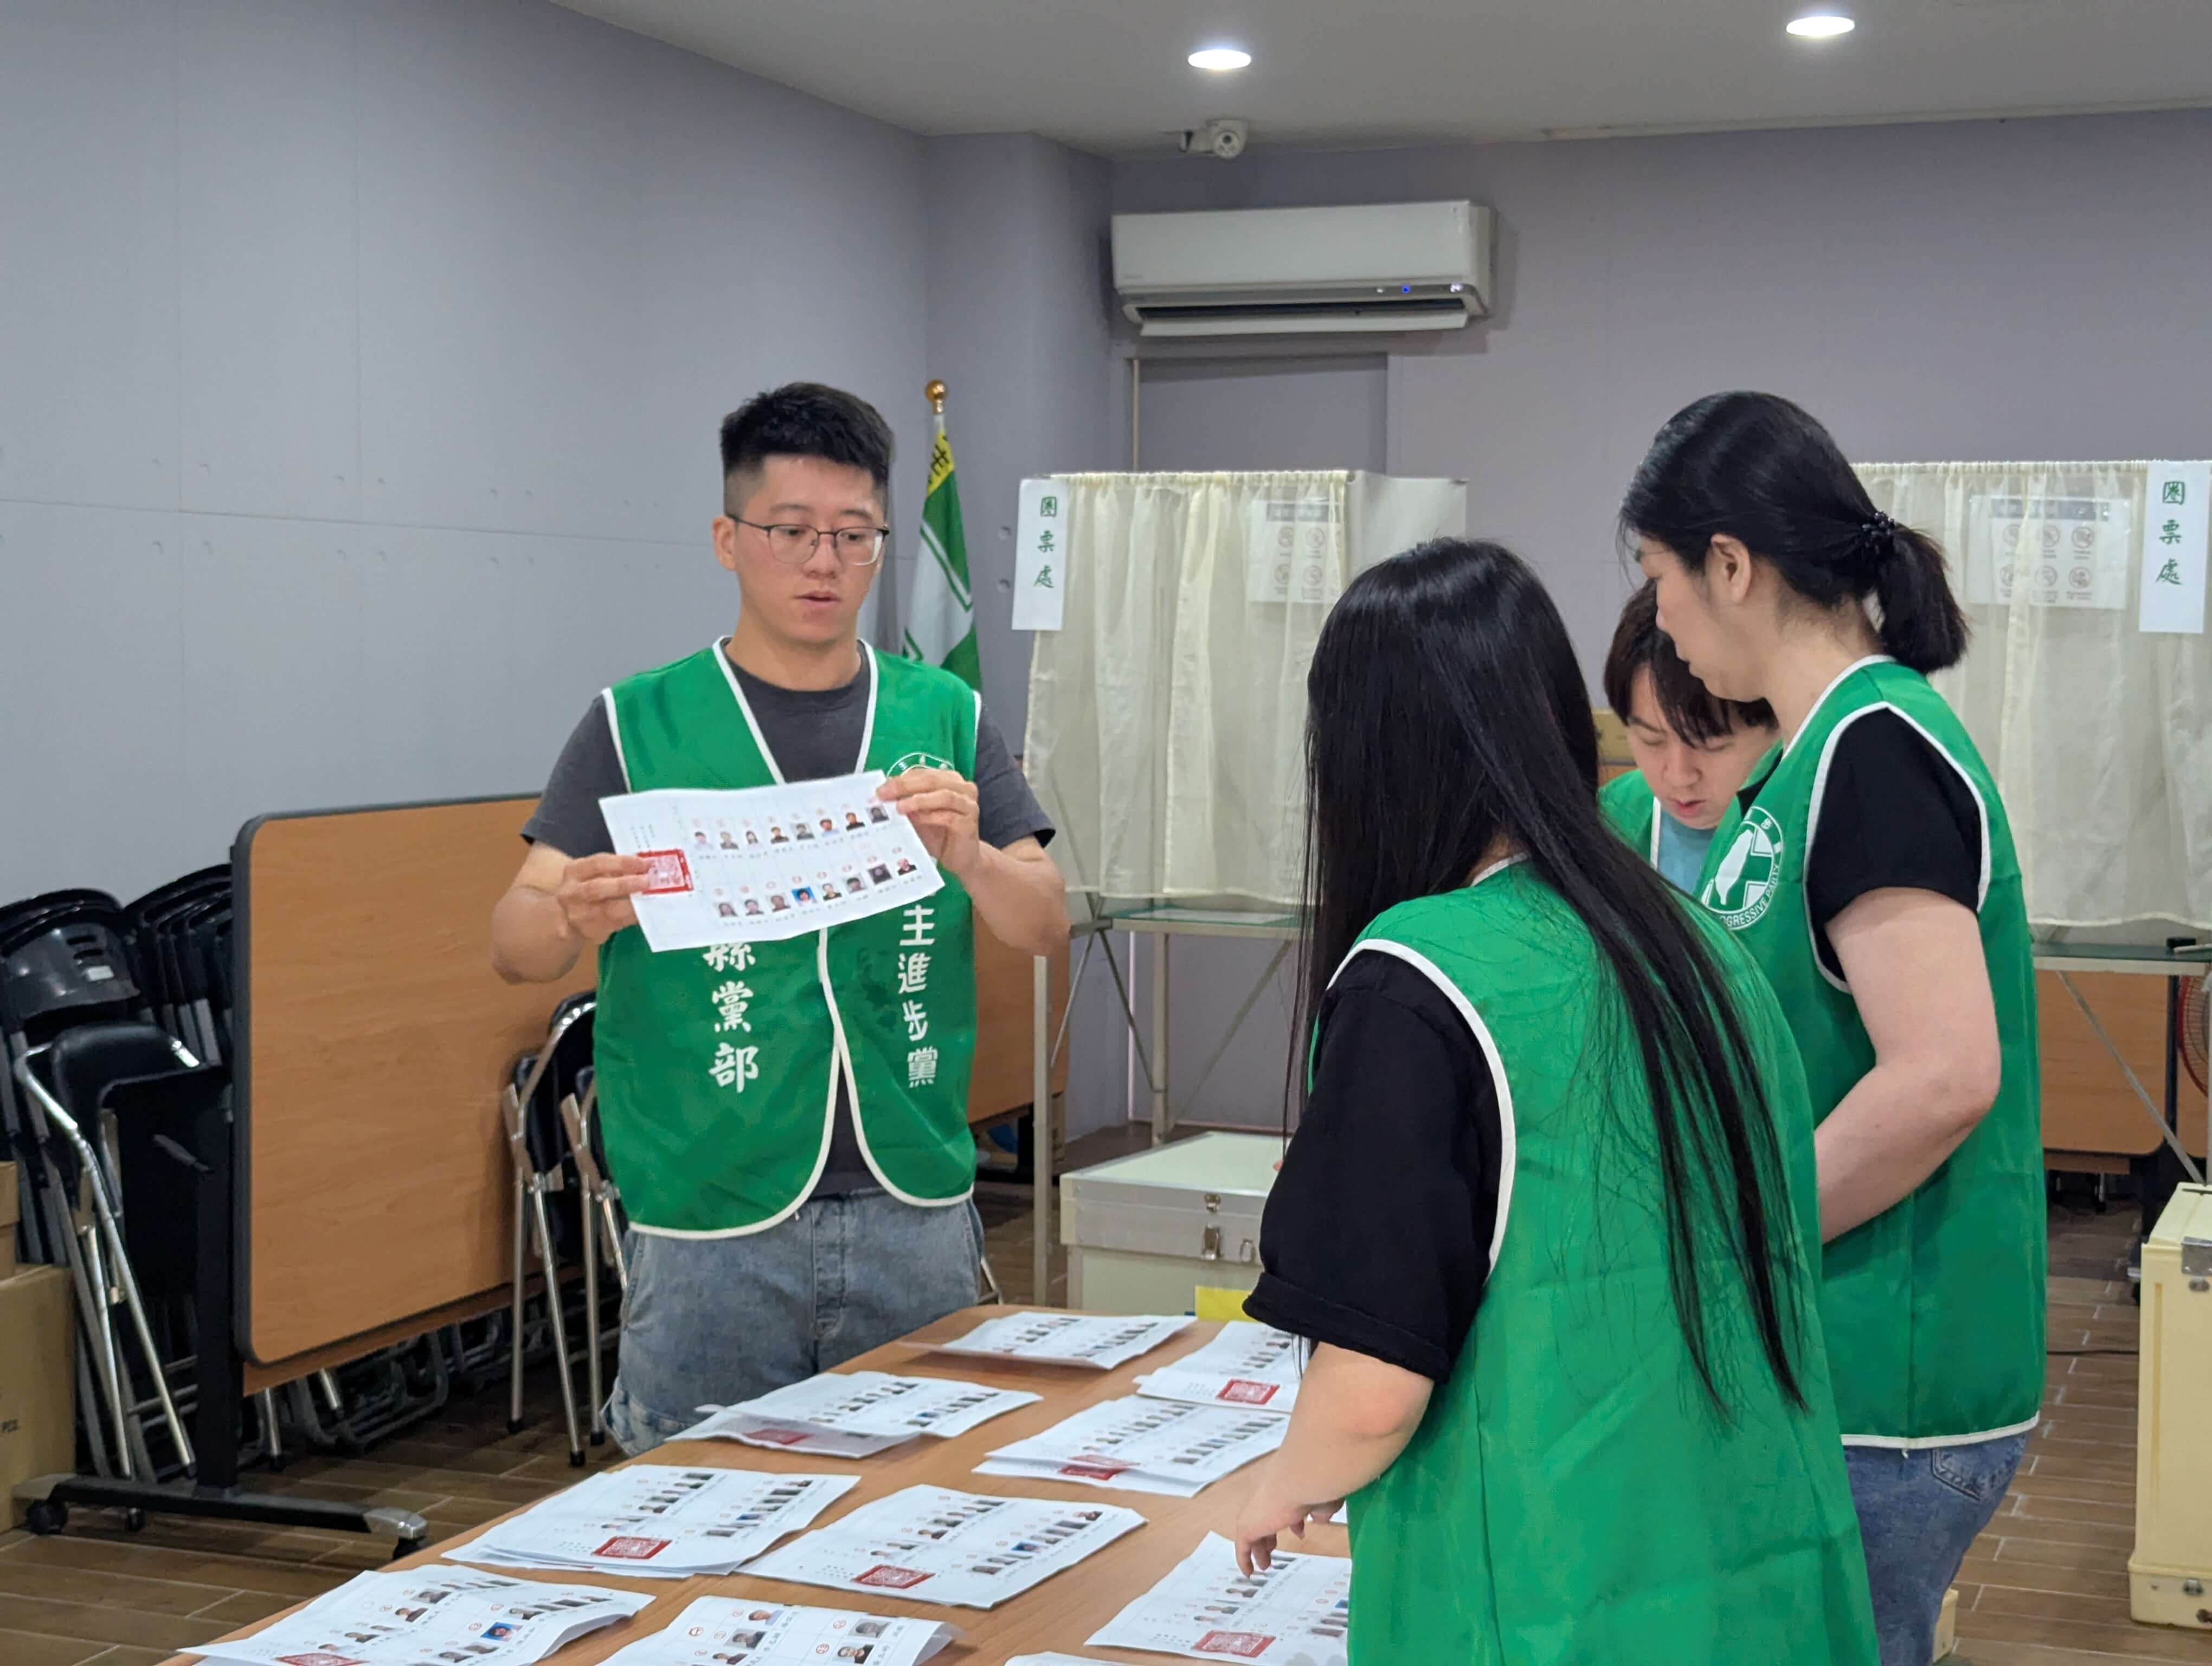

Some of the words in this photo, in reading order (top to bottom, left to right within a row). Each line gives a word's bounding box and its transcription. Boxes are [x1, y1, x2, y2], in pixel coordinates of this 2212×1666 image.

[1033, 496, 1057, 588] 圈票處
[2156, 481, 2185, 585] 圈票處
[1765, 863, 1779, 899] PARTY
[897, 893, 938, 1088] 主進步黨
